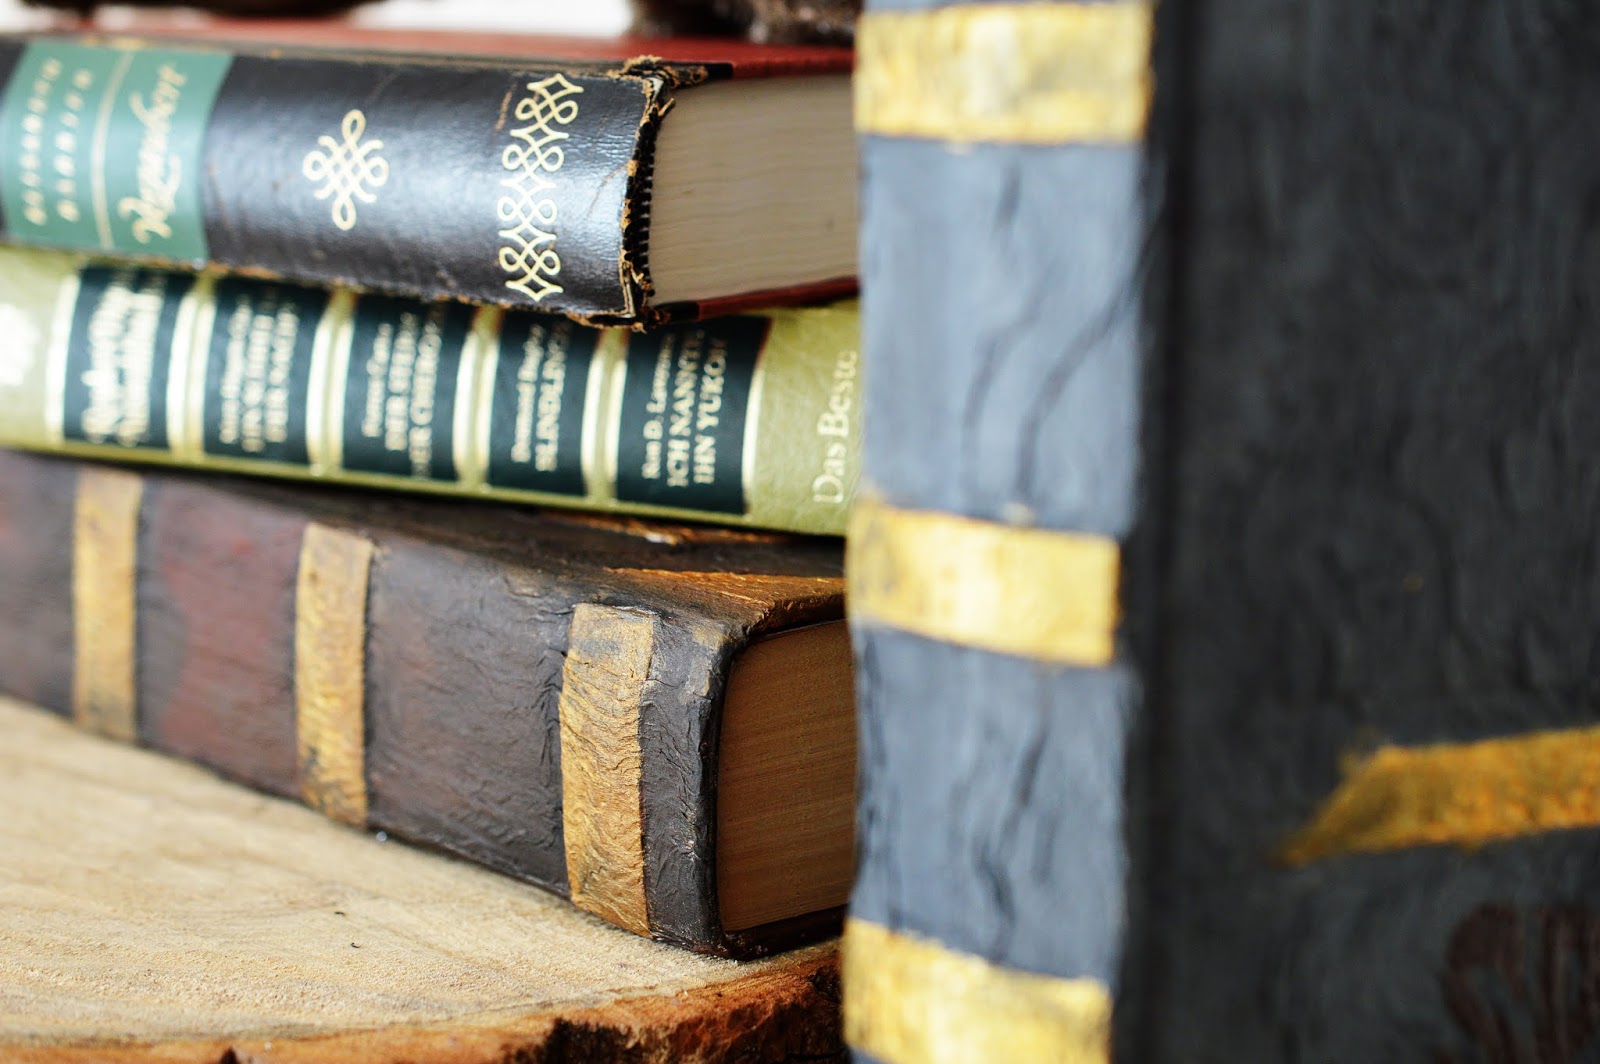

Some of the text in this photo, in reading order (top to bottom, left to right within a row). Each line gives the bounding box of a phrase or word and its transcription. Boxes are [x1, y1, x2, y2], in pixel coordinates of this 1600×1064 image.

[813, 351, 857, 503] Das Beste
[667, 439, 690, 486] ICH
[694, 436, 715, 483] IHN
